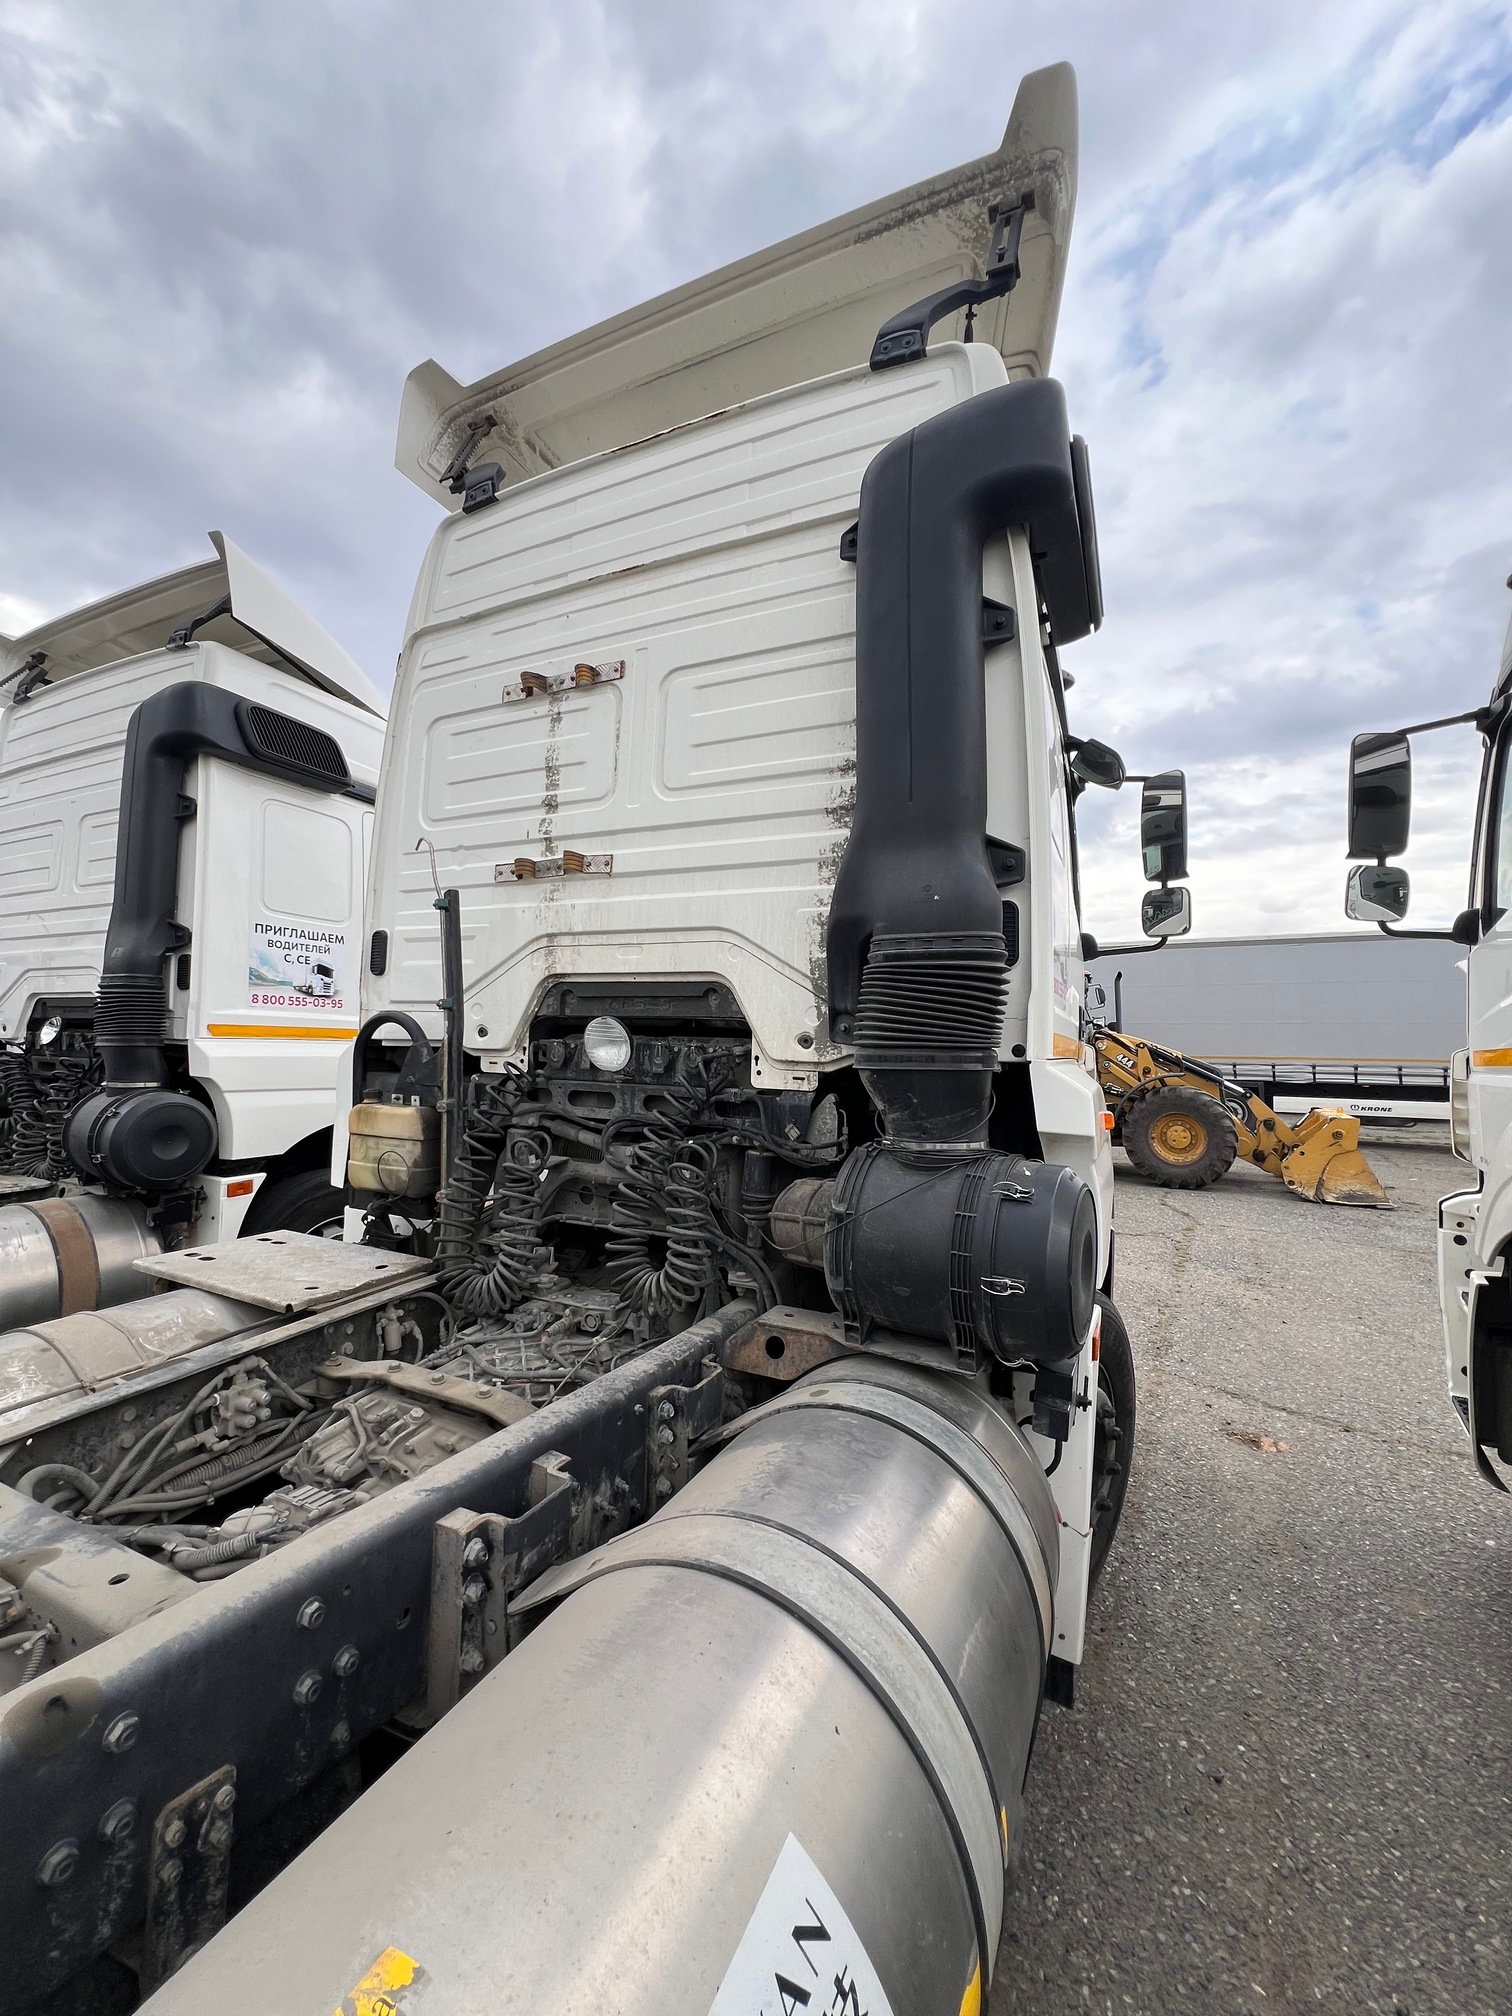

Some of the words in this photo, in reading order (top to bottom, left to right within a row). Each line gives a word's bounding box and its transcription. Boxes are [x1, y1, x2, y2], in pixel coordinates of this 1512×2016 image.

[254, 923, 345, 945] ПРИГЛАШАЕМ
[267, 939, 331, 955] ВОДИТЕЛЕЙ
[251, 994, 259, 1004] 8
[262, 994, 286, 1006] 800
[287, 996, 344, 1009] 555-03-95
[1116, 1053, 1135, 1069] 444
